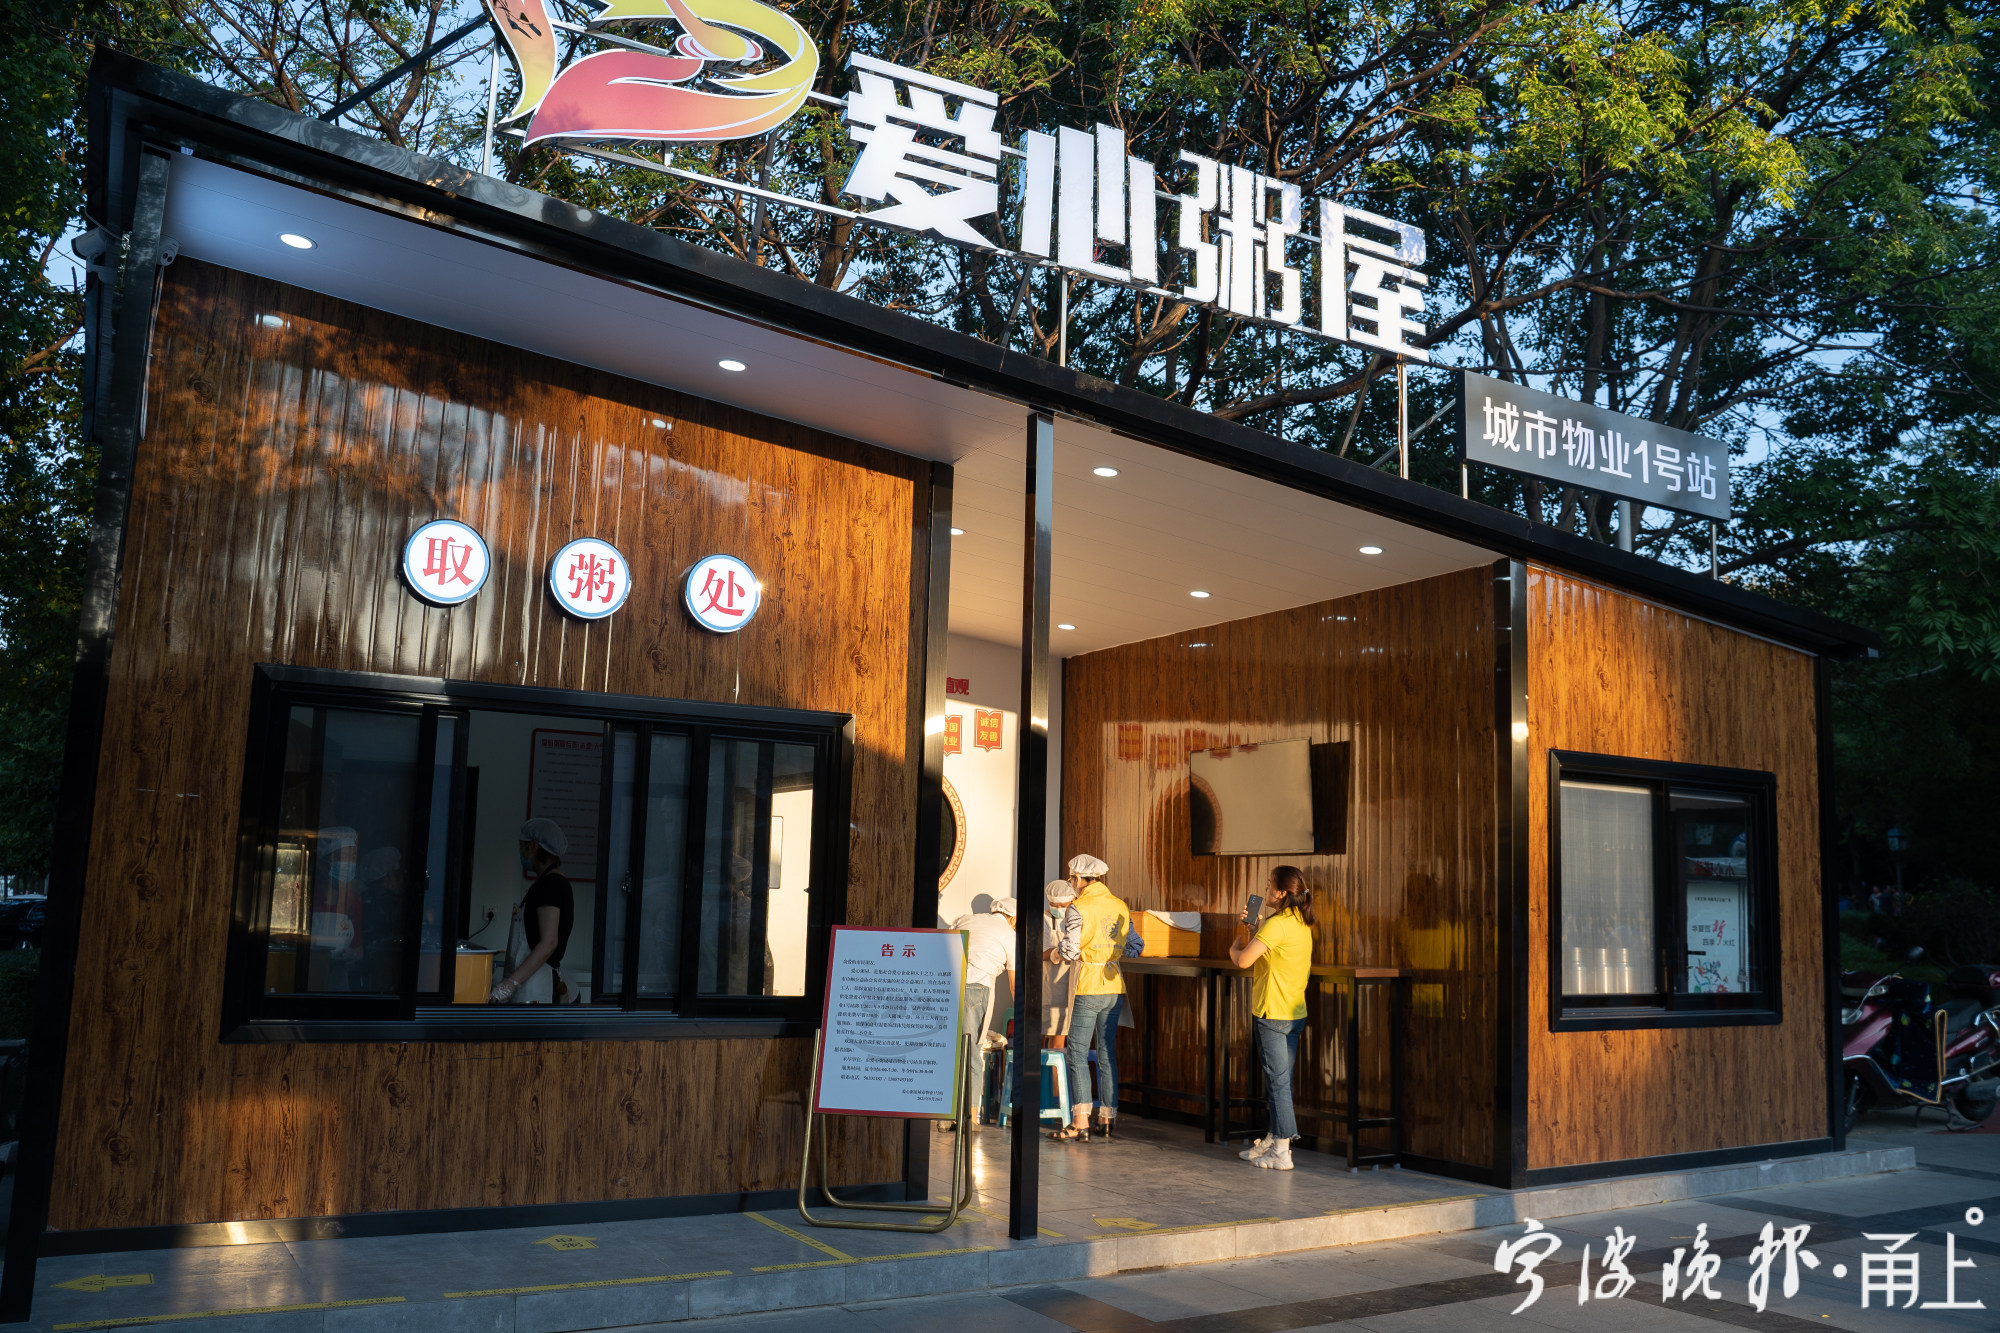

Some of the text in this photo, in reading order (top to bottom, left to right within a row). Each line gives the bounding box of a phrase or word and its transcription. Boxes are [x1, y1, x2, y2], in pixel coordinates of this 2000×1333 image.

[842, 52, 1429, 361] 爱心粥屋
[1482, 397, 1716, 500] 城市物业1号站
[423, 536, 745, 617] 取粥处
[980, 717, 999, 728] 诚信
[980, 731, 999, 742] 友善
[881, 943, 917, 958] 告示
